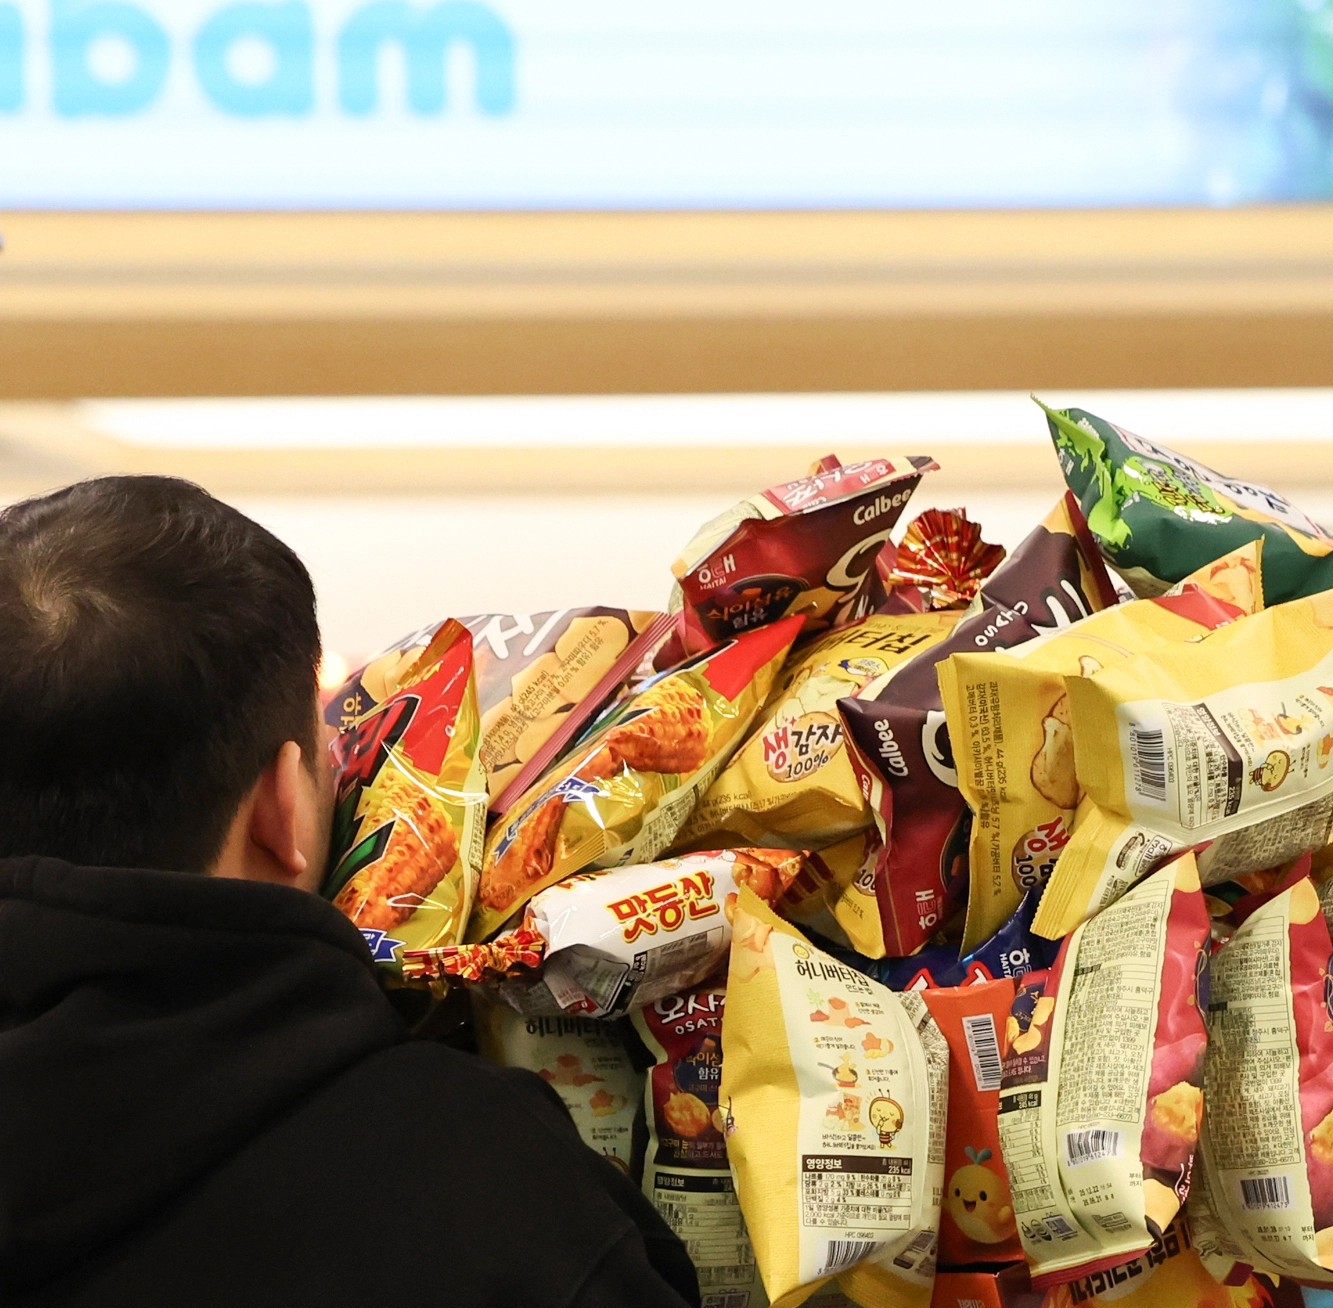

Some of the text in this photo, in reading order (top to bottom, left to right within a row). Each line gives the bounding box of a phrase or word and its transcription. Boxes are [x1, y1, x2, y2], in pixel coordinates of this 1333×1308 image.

[853, 488, 912, 525] Calbee
[557, 635, 593, 673] 고구마파우더
[532, 669, 549, 687] kcal)
[966, 685, 977, 714] 고메버터
[976, 683, 990, 725] 감자(미국산)
[968, 716, 978, 728] 0.3
[981, 727, 991, 743] 63.5
[761, 723, 844, 771] 생감자
[875, 718, 908, 777] Calbee
[997, 748, 1003, 759] 44
[785, 750, 829, 779] 100%
[970, 741, 984, 787] 아카시아벌꿀
[996, 761, 1007, 784] g(235
[604, 870, 721, 944] 맛동산
[795, 960, 870, 987] 허니버터칩
[653, 995, 725, 1024] 오사
[675, 1018, 723, 1035] OSAT
[698, 1067, 719, 1080] 함유
[806, 1159, 842, 1169] 영양정보
[888, 1166, 911, 1174] 235 kcal
